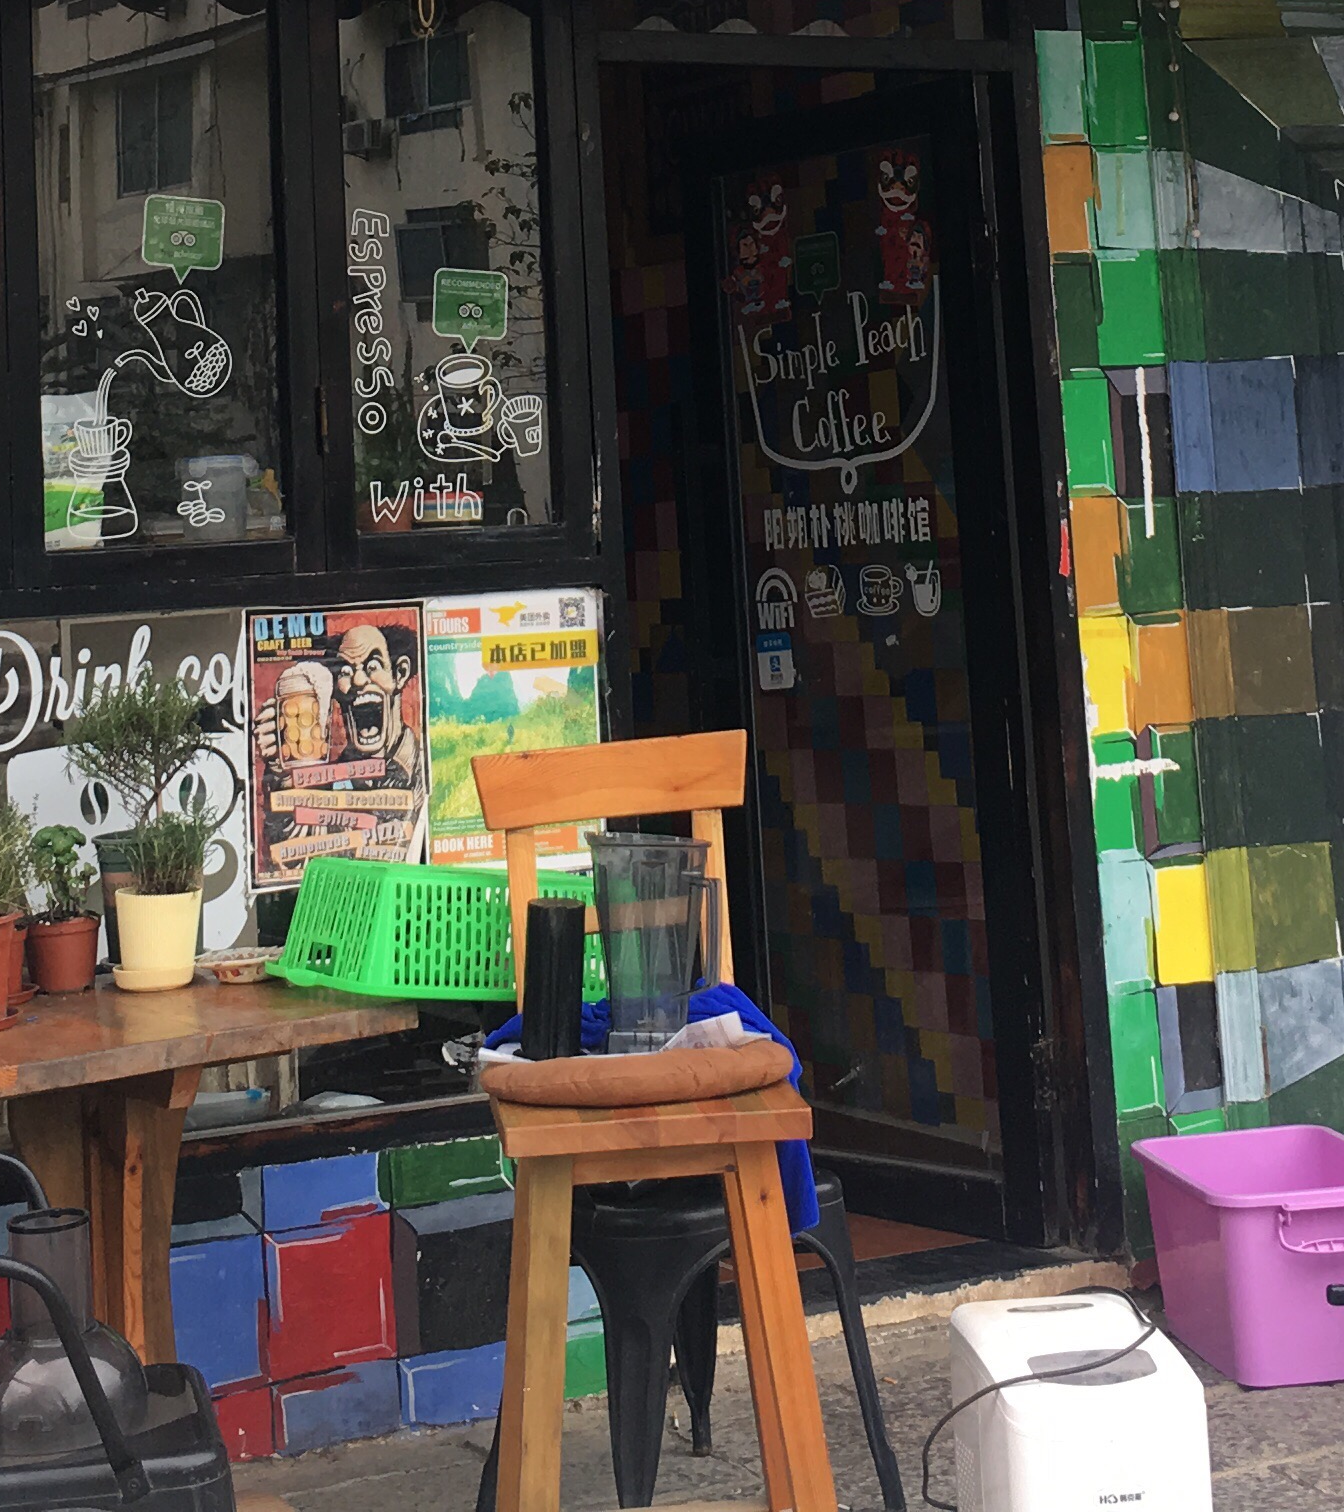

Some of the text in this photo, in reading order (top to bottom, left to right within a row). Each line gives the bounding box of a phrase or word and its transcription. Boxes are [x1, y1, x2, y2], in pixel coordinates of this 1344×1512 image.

[752, 290, 928, 391] Simple Peach
[791, 388, 892, 454] Coffee
[763, 497, 932, 551] 阳朔朴桃咖啡馆
[255, 612, 325, 641] DEMO
[432, 616, 470, 634] TOURS
[757, 600, 795, 630] WiFi
[257, 637, 313, 652] CRAFT BEER
[428, 640, 482, 652] countryside
[489, 638, 587, 664] 本店已加盟
[275, 792, 409, 808] American Breakfast
[433, 834, 494, 854] BOOK HERE
